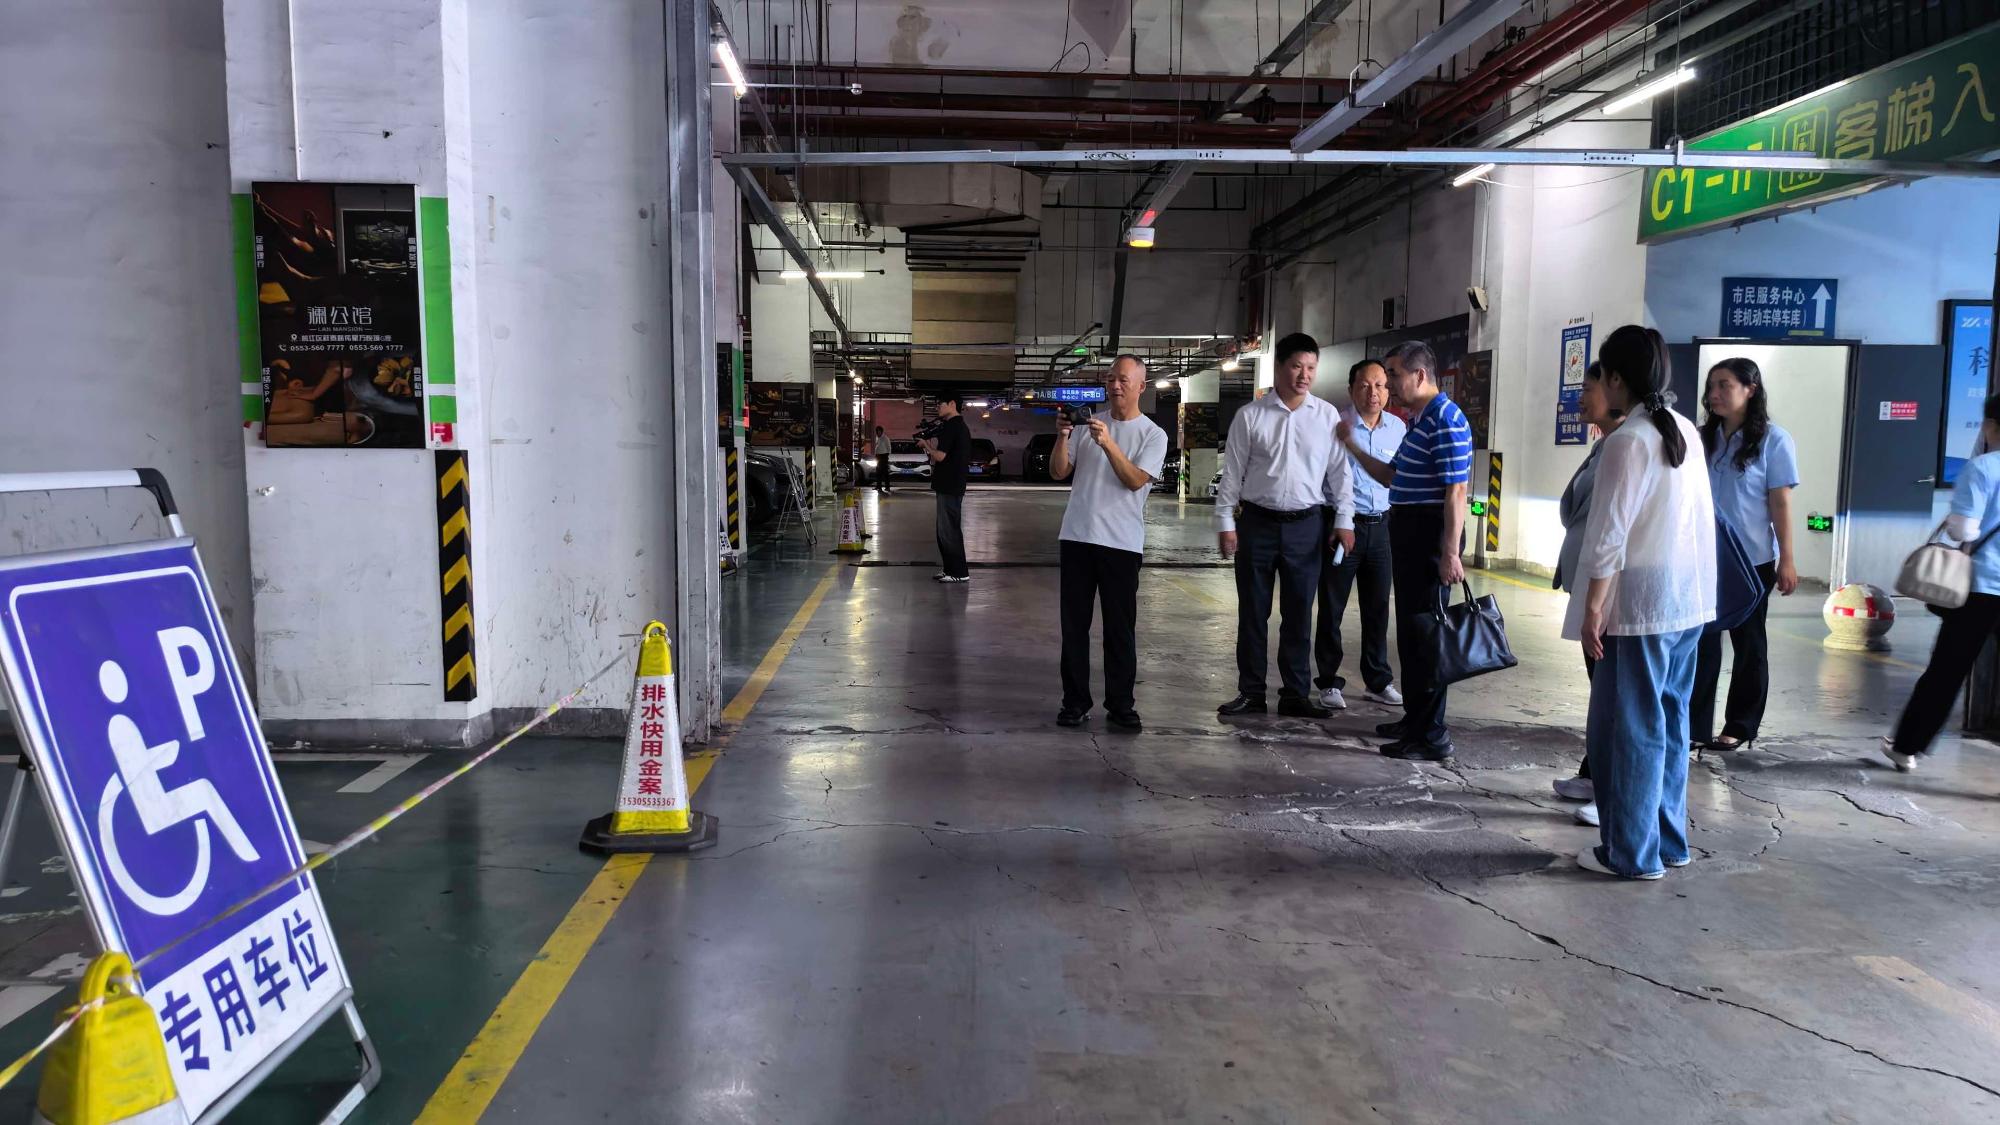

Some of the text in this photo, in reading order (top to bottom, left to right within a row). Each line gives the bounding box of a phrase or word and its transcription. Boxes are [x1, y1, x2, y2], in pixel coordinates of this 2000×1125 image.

[307, 306, 372, 325] 澜公馆
[1732, 286, 1805, 305] 市民服务中心
[157, 626, 216, 741] P
[638, 684, 666, 795] 排水快用金案
[623, 797, 676, 806] 15305535367
[159, 908, 329, 1073] 专用车位
